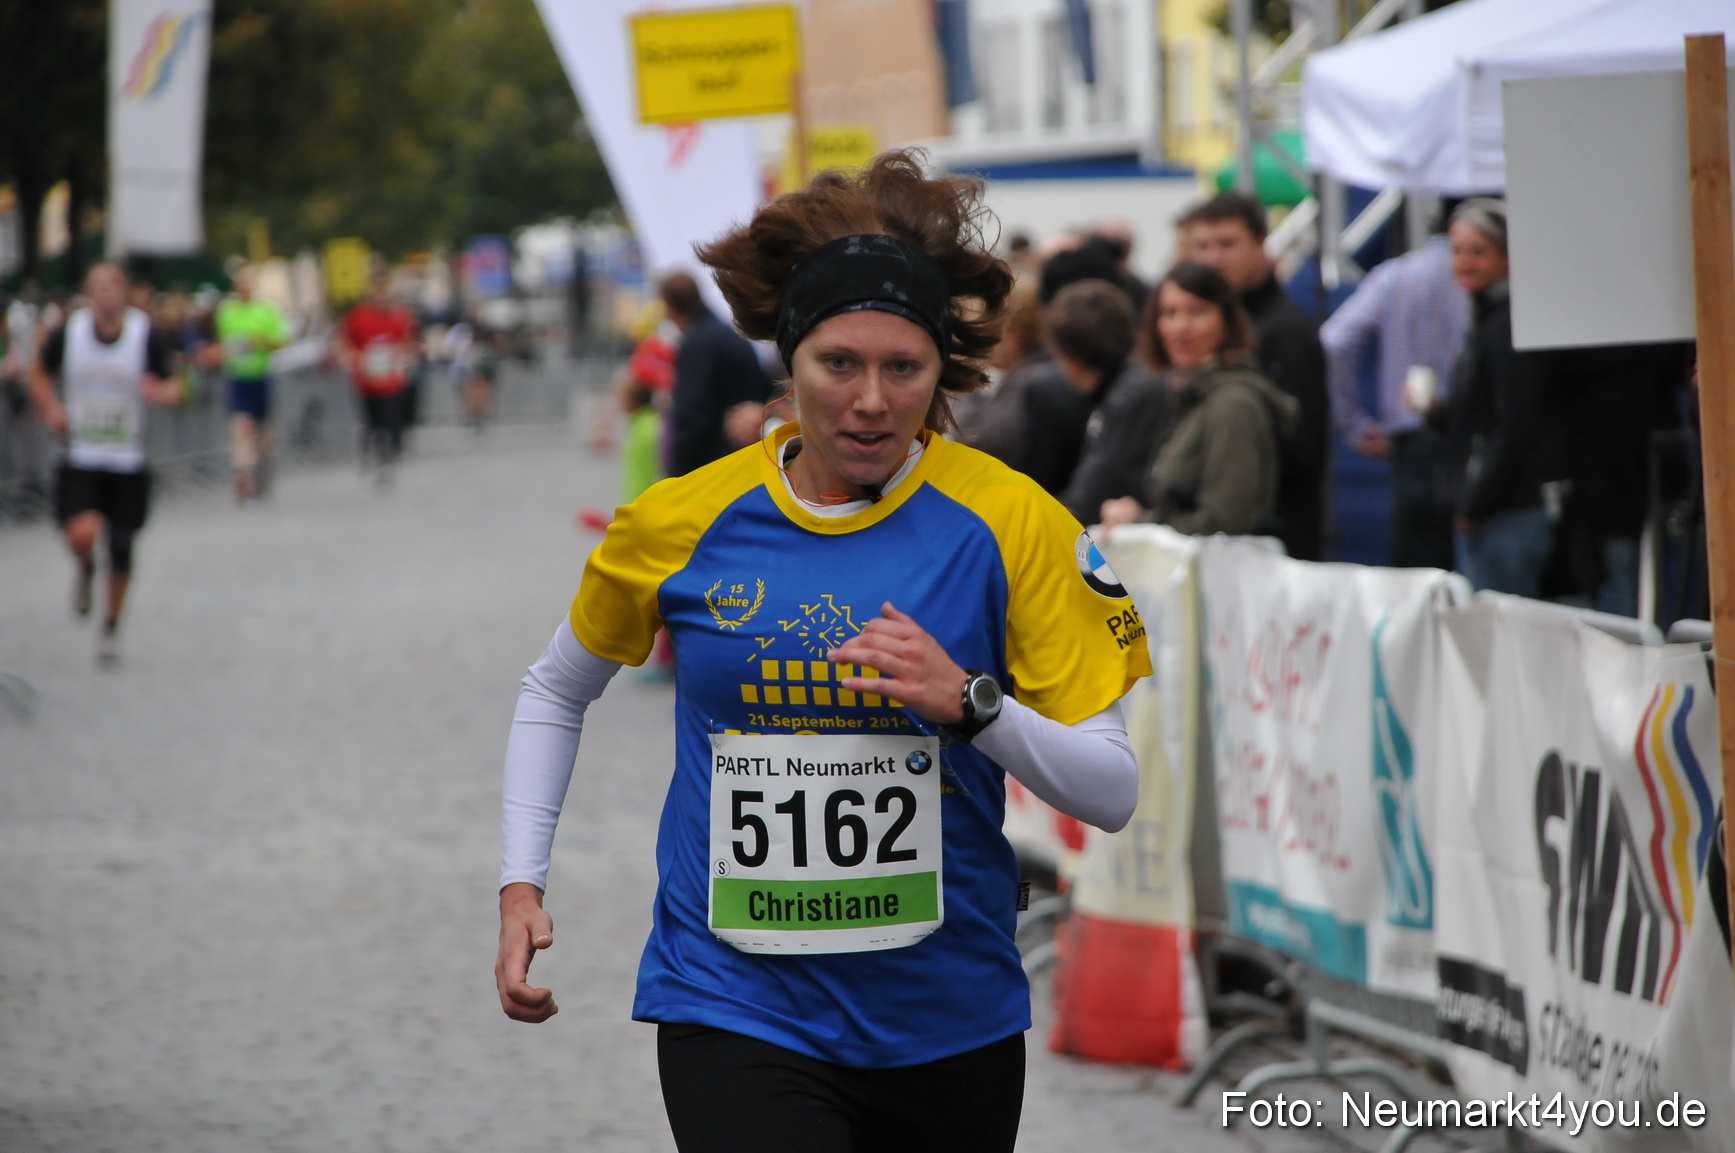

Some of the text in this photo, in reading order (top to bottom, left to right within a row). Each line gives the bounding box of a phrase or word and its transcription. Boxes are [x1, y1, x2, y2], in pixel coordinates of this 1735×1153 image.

[730, 584, 744, 593] 15
[717, 595, 749, 607] Jahre
[748, 713, 910, 729] 21.September 2014
[716, 755, 896, 777] PARTL Neumarkt
[731, 786, 918, 868] 5162
[718, 862, 725, 875] S
[749, 890, 899, 922] Christiane
